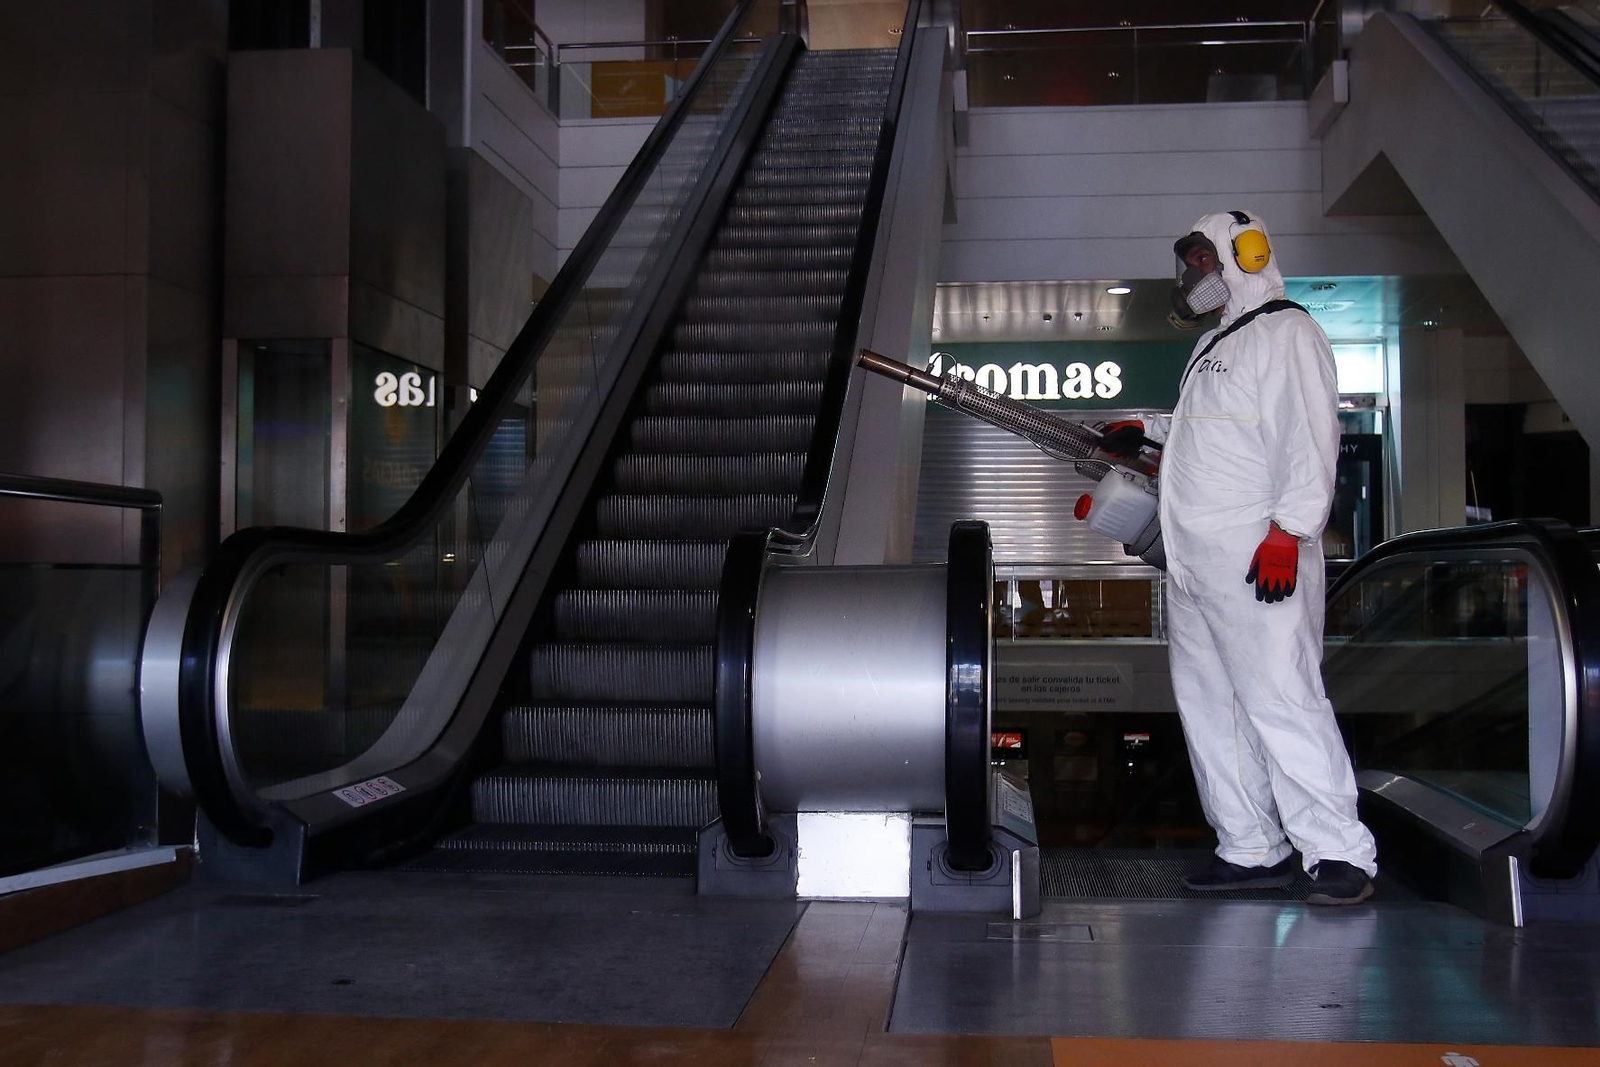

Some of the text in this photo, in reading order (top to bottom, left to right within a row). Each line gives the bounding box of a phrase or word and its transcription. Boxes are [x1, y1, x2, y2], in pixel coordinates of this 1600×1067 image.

[1009, 675, 1019, 684] de
[1042, 675, 1083, 684] convalida
[1085, 676, 1094, 684] tu
[1096, 675, 1120, 684] ticket
[1034, 684, 1047, 693] los
[1049, 685, 1081, 695] cajeros
